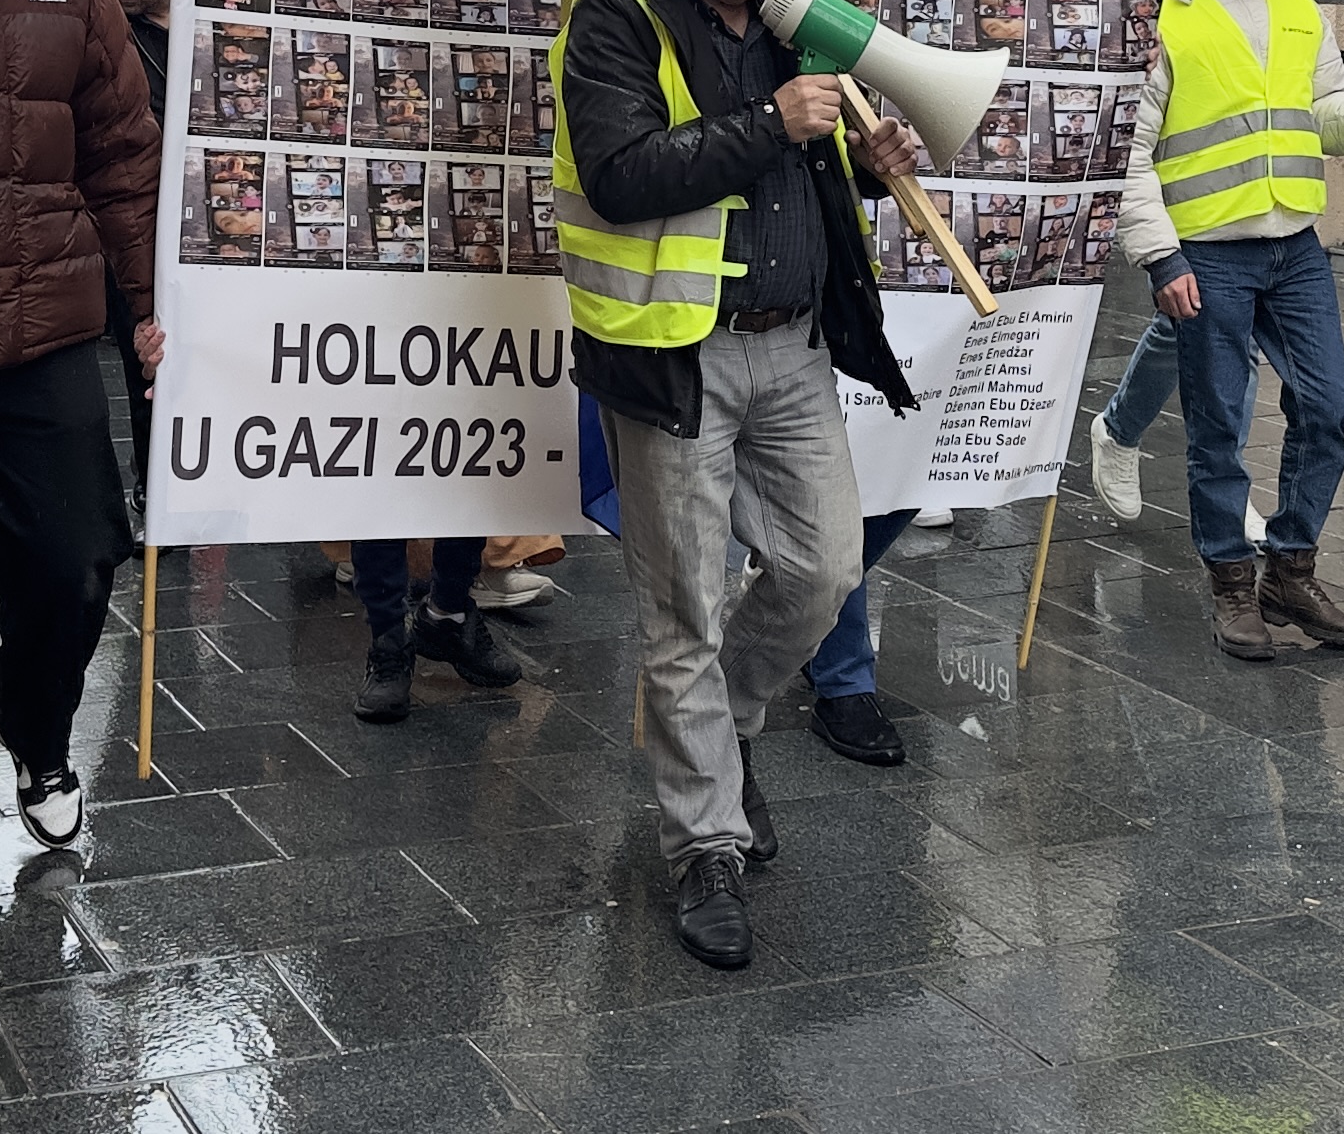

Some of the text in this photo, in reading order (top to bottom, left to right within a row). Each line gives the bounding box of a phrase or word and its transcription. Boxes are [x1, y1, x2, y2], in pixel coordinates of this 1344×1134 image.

[968, 316, 995, 333] Amal
[964, 336, 989, 349] Enes
[271, 322, 577, 389] HOLOKAU
[959, 352, 983, 365] Enes
[955, 367, 983, 382] Tamir
[998, 363, 1032, 376] Amsi
[987, 380, 1044, 394] Mahmud
[944, 398, 986, 414] Dženan
[989, 397, 1017, 411] Ebu
[939, 416, 976, 431] Hasan
[935, 432, 1027, 448] Hala Ebu Sade
[170, 415, 212, 481] U
[233, 415, 379, 480] GAZI
[394, 417, 527, 478] 2023
[931, 450, 1000, 465] Hala Asref
[928, 468, 969, 482] Hasan
[974, 468, 990, 482] Ve
[994, 468, 1021, 482] Malik
